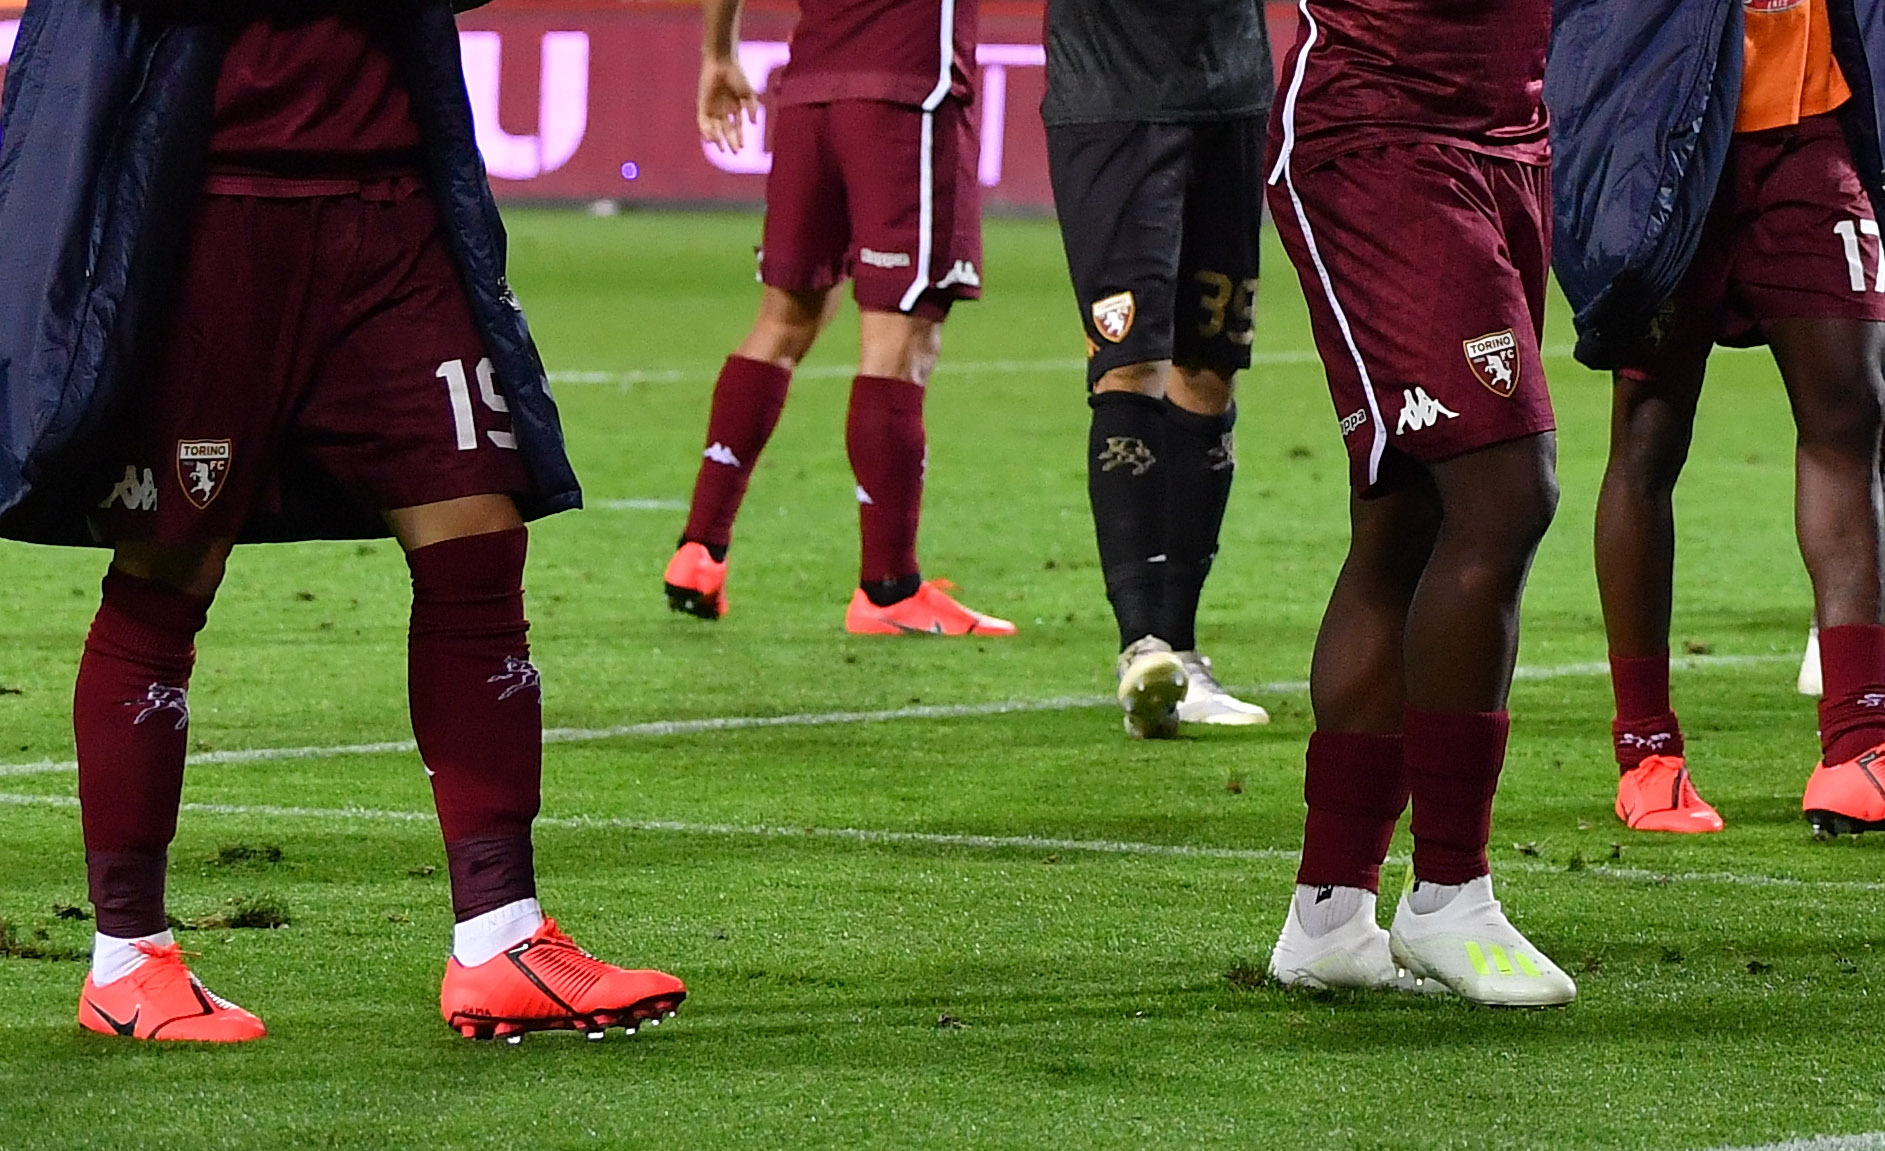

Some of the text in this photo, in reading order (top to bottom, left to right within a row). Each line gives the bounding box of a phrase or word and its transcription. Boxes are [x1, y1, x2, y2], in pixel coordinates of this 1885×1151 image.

[1193, 268, 1259, 346] 39
[1470, 336, 1512, 354] TORINO
[1501, 350, 1516, 360] FC
[183, 444, 226, 457] TORINO
[210, 460, 225, 471] FC
